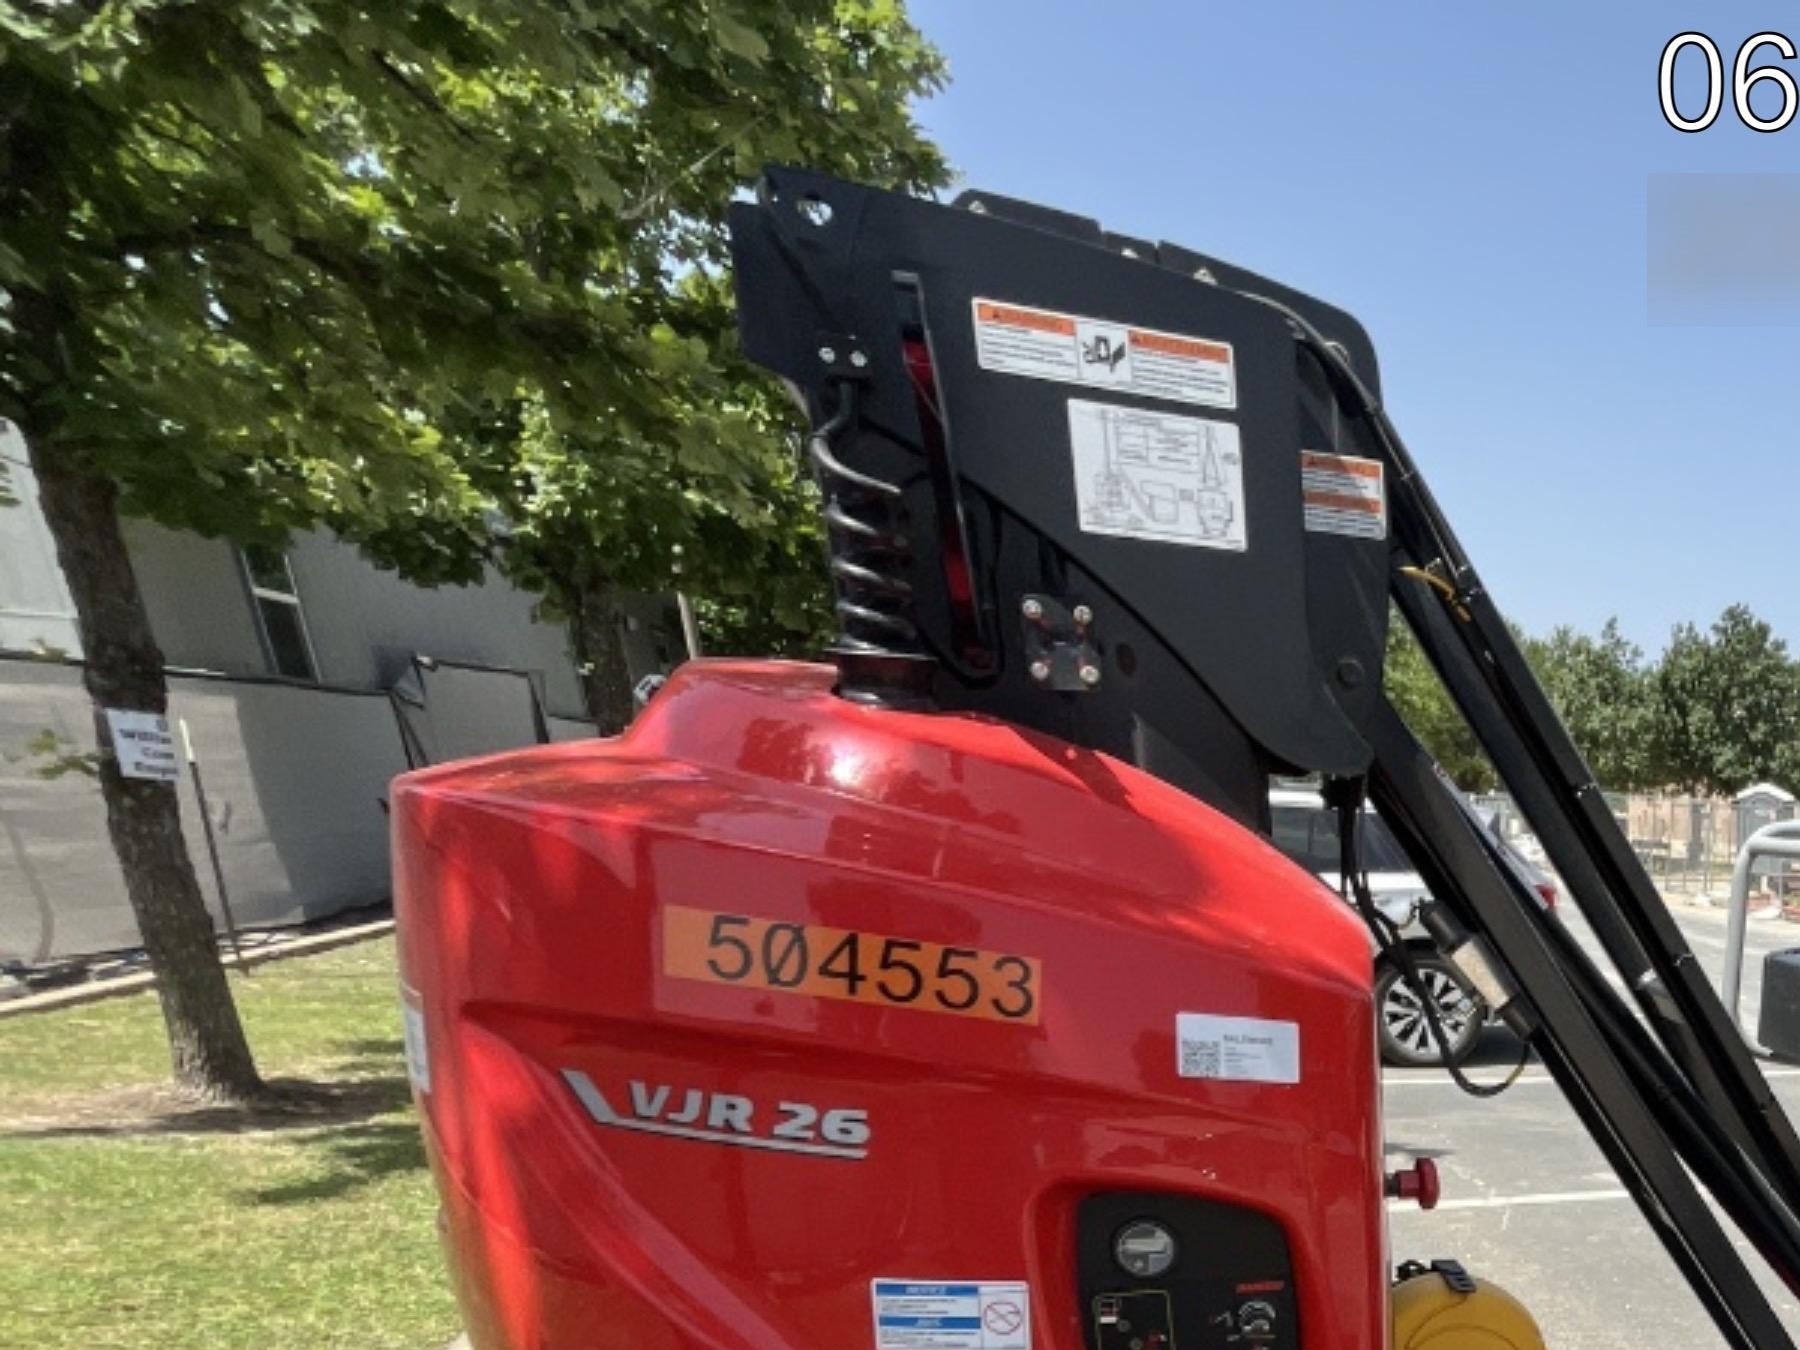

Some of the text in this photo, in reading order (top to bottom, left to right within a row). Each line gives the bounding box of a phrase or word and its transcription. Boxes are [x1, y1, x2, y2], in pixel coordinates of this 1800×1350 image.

[706, 915, 1034, 1018] 504553
[629, 1080, 871, 1145] VJR 26
